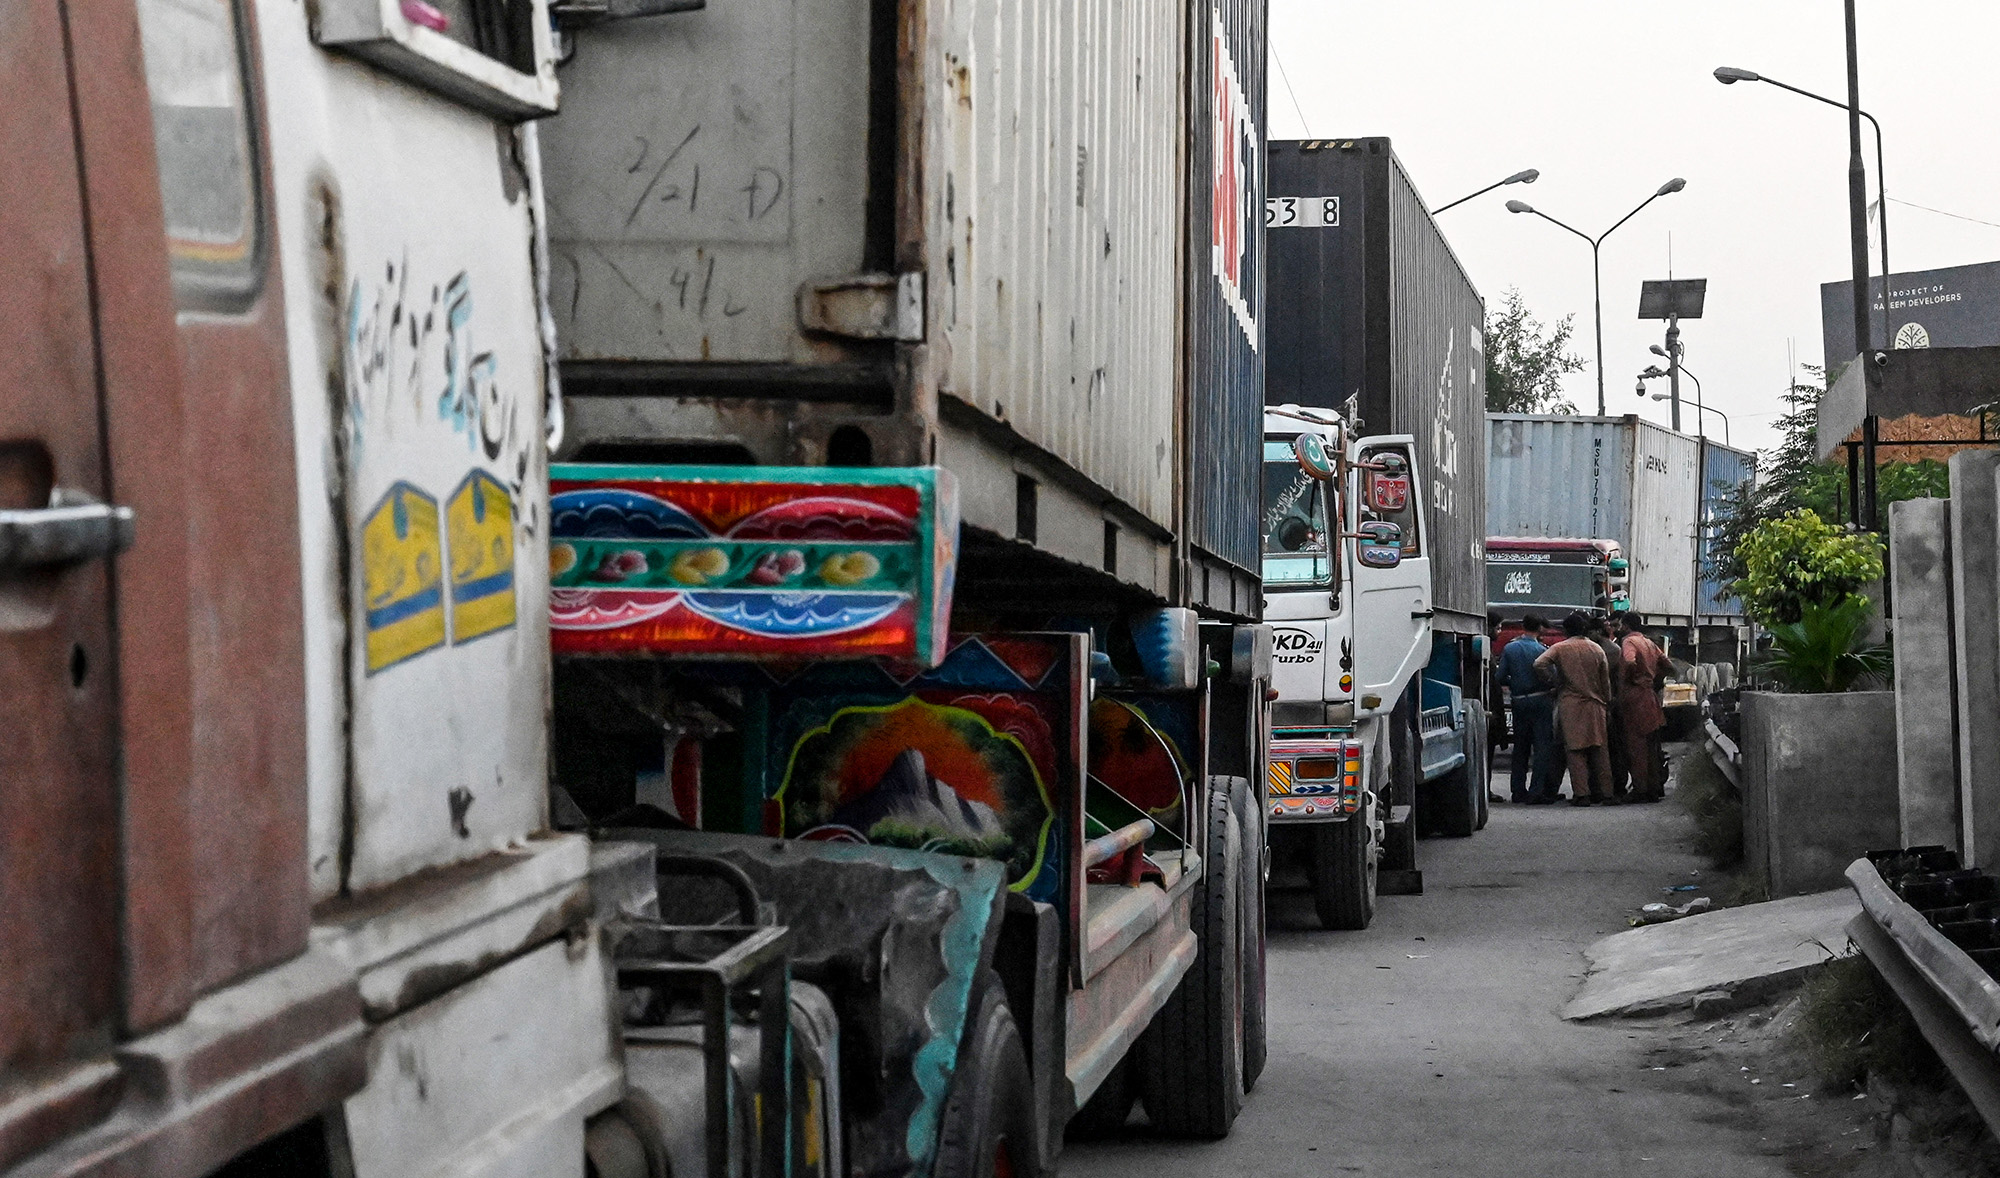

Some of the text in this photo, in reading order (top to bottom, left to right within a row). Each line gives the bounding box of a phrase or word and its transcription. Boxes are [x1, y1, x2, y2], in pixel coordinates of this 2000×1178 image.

[1323, 198, 1338, 225] 8
[1932, 285, 1944, 293] OF
[1873, 293, 1962, 311] RAEEM DEVELOPERS
